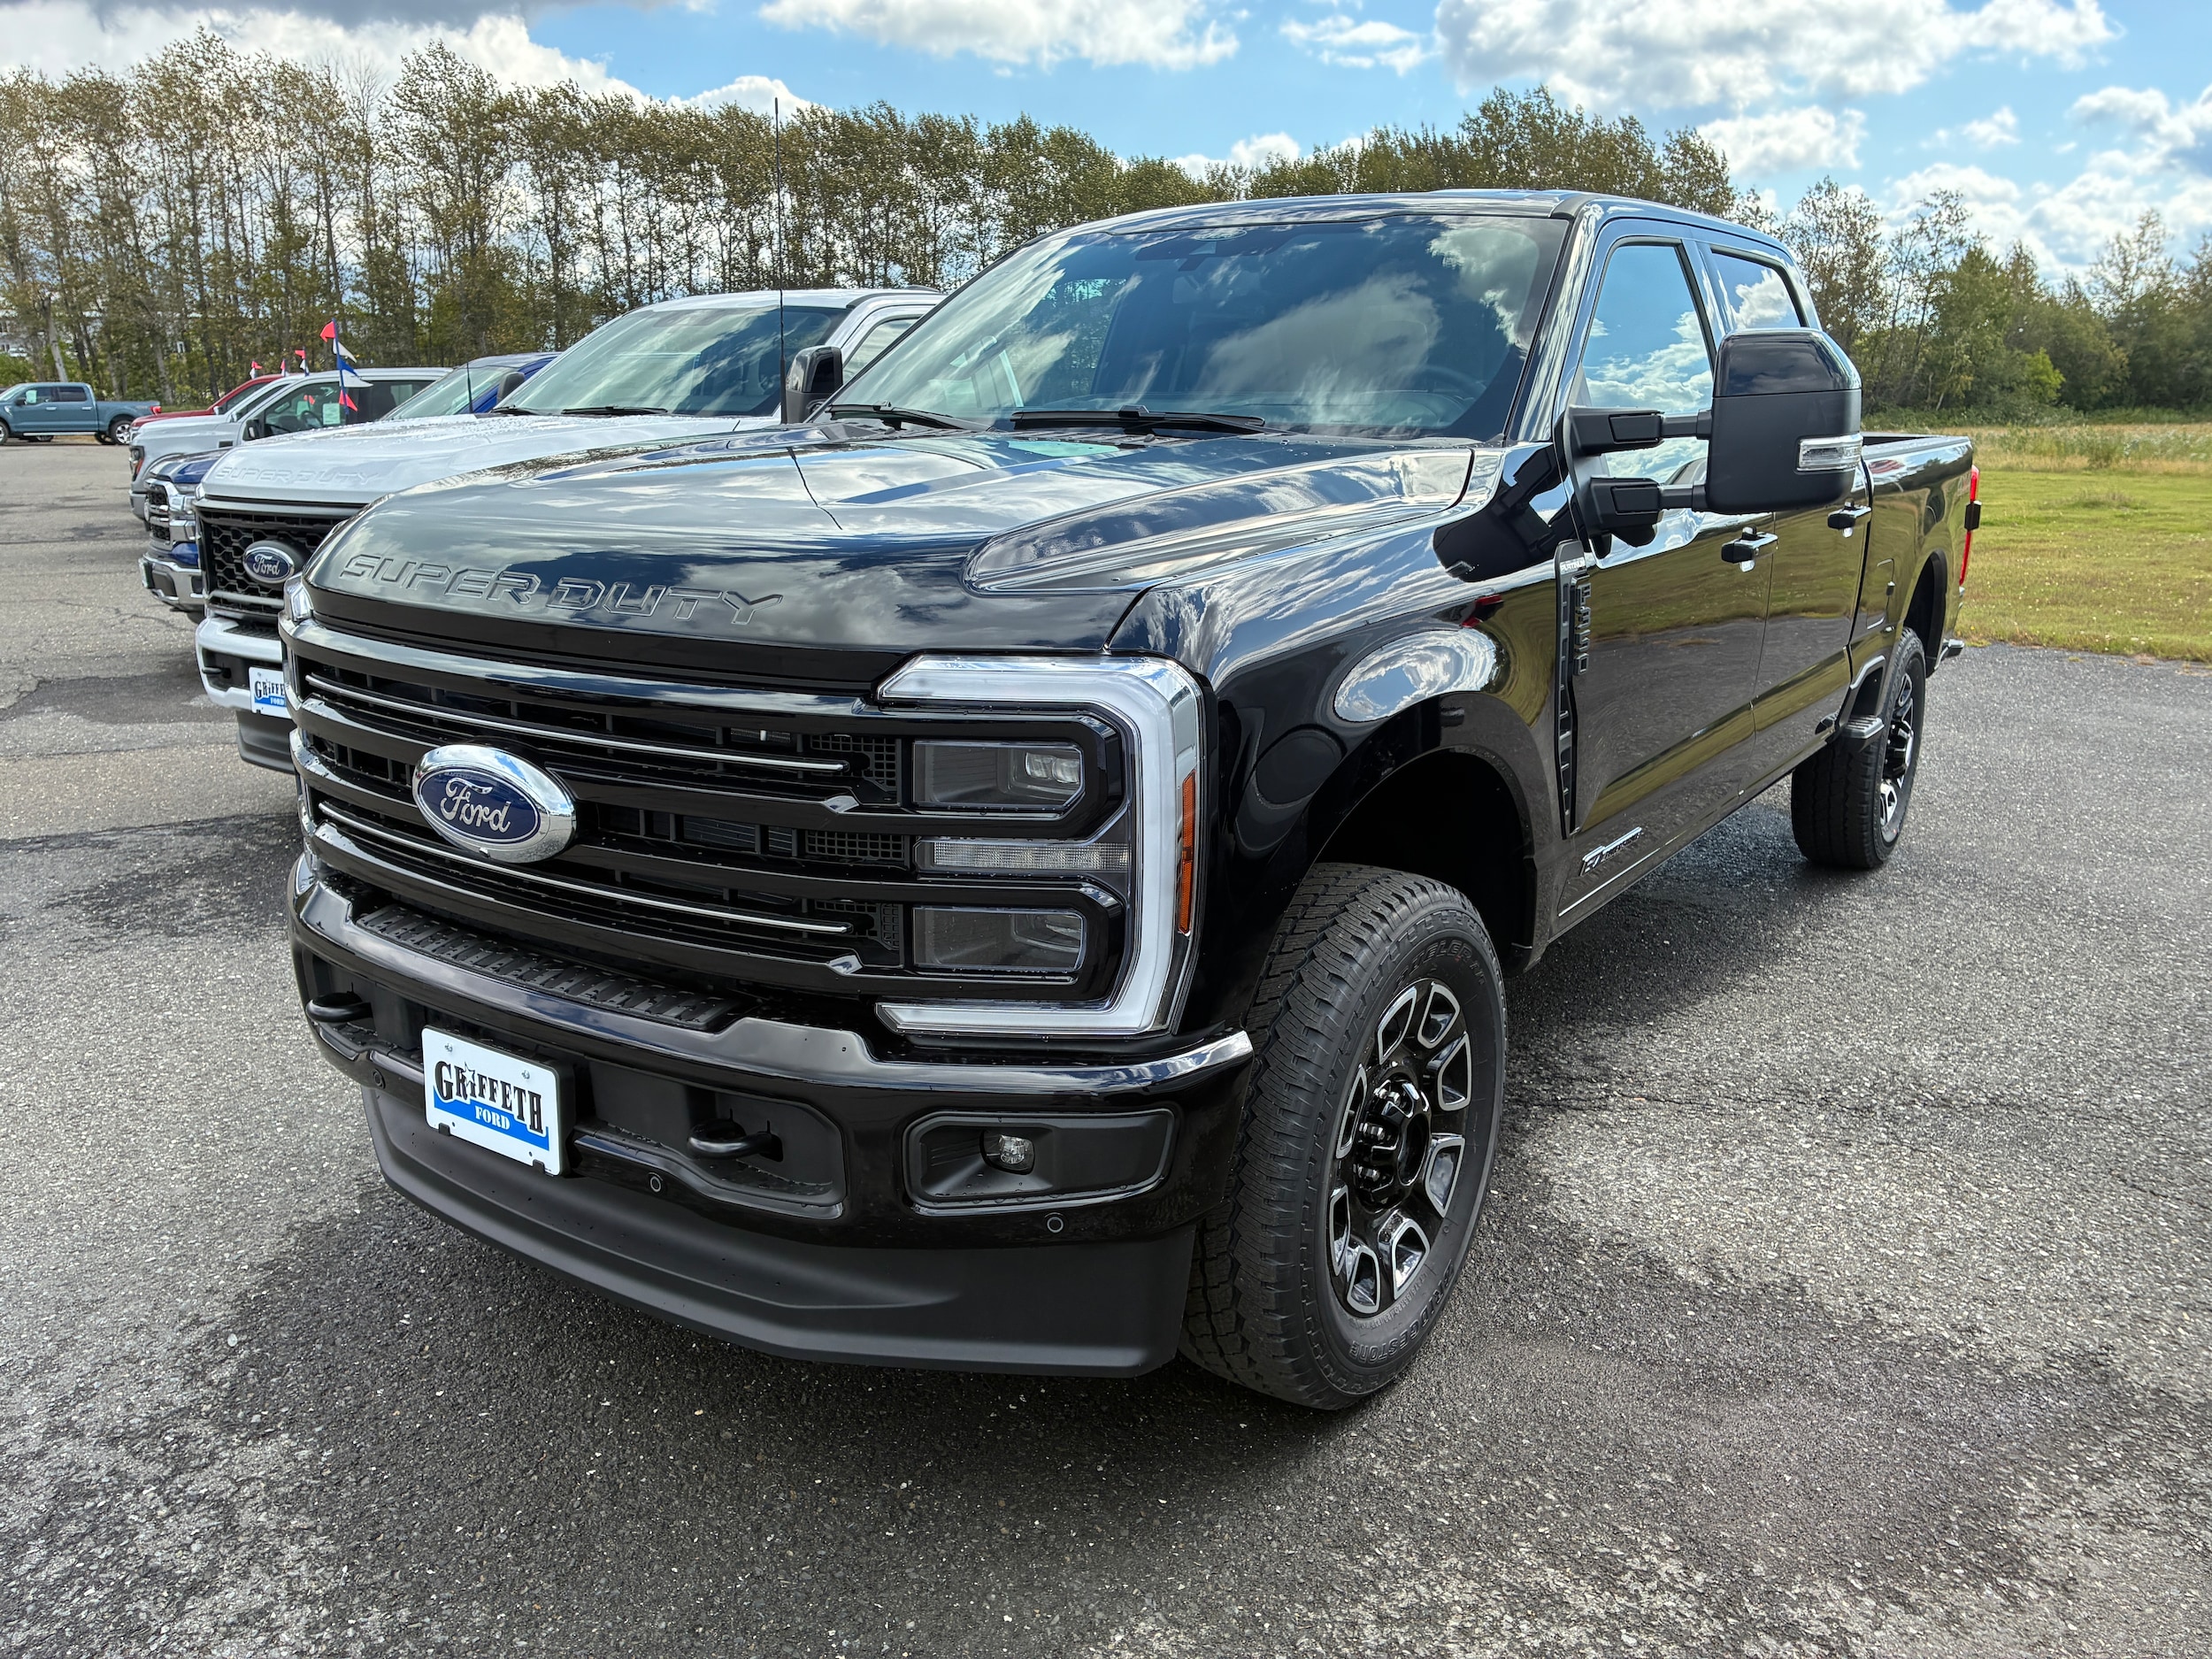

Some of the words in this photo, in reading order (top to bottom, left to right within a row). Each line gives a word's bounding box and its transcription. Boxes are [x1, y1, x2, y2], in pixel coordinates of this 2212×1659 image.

[214, 466, 290, 483] SUPER
[293, 470, 379, 486] DUTY
[253, 553, 280, 575] Ford
[340, 554, 541, 605] SUPER
[546, 577, 783, 625] DUTY
[255, 680, 285, 698] GRIFFE
[441, 777, 511, 833] Ford
[434, 1061, 543, 1134] GRIFFETH
[474, 1105, 511, 1131] FORD
[1349, 1259, 1454, 1363] BRIDGESTONE
